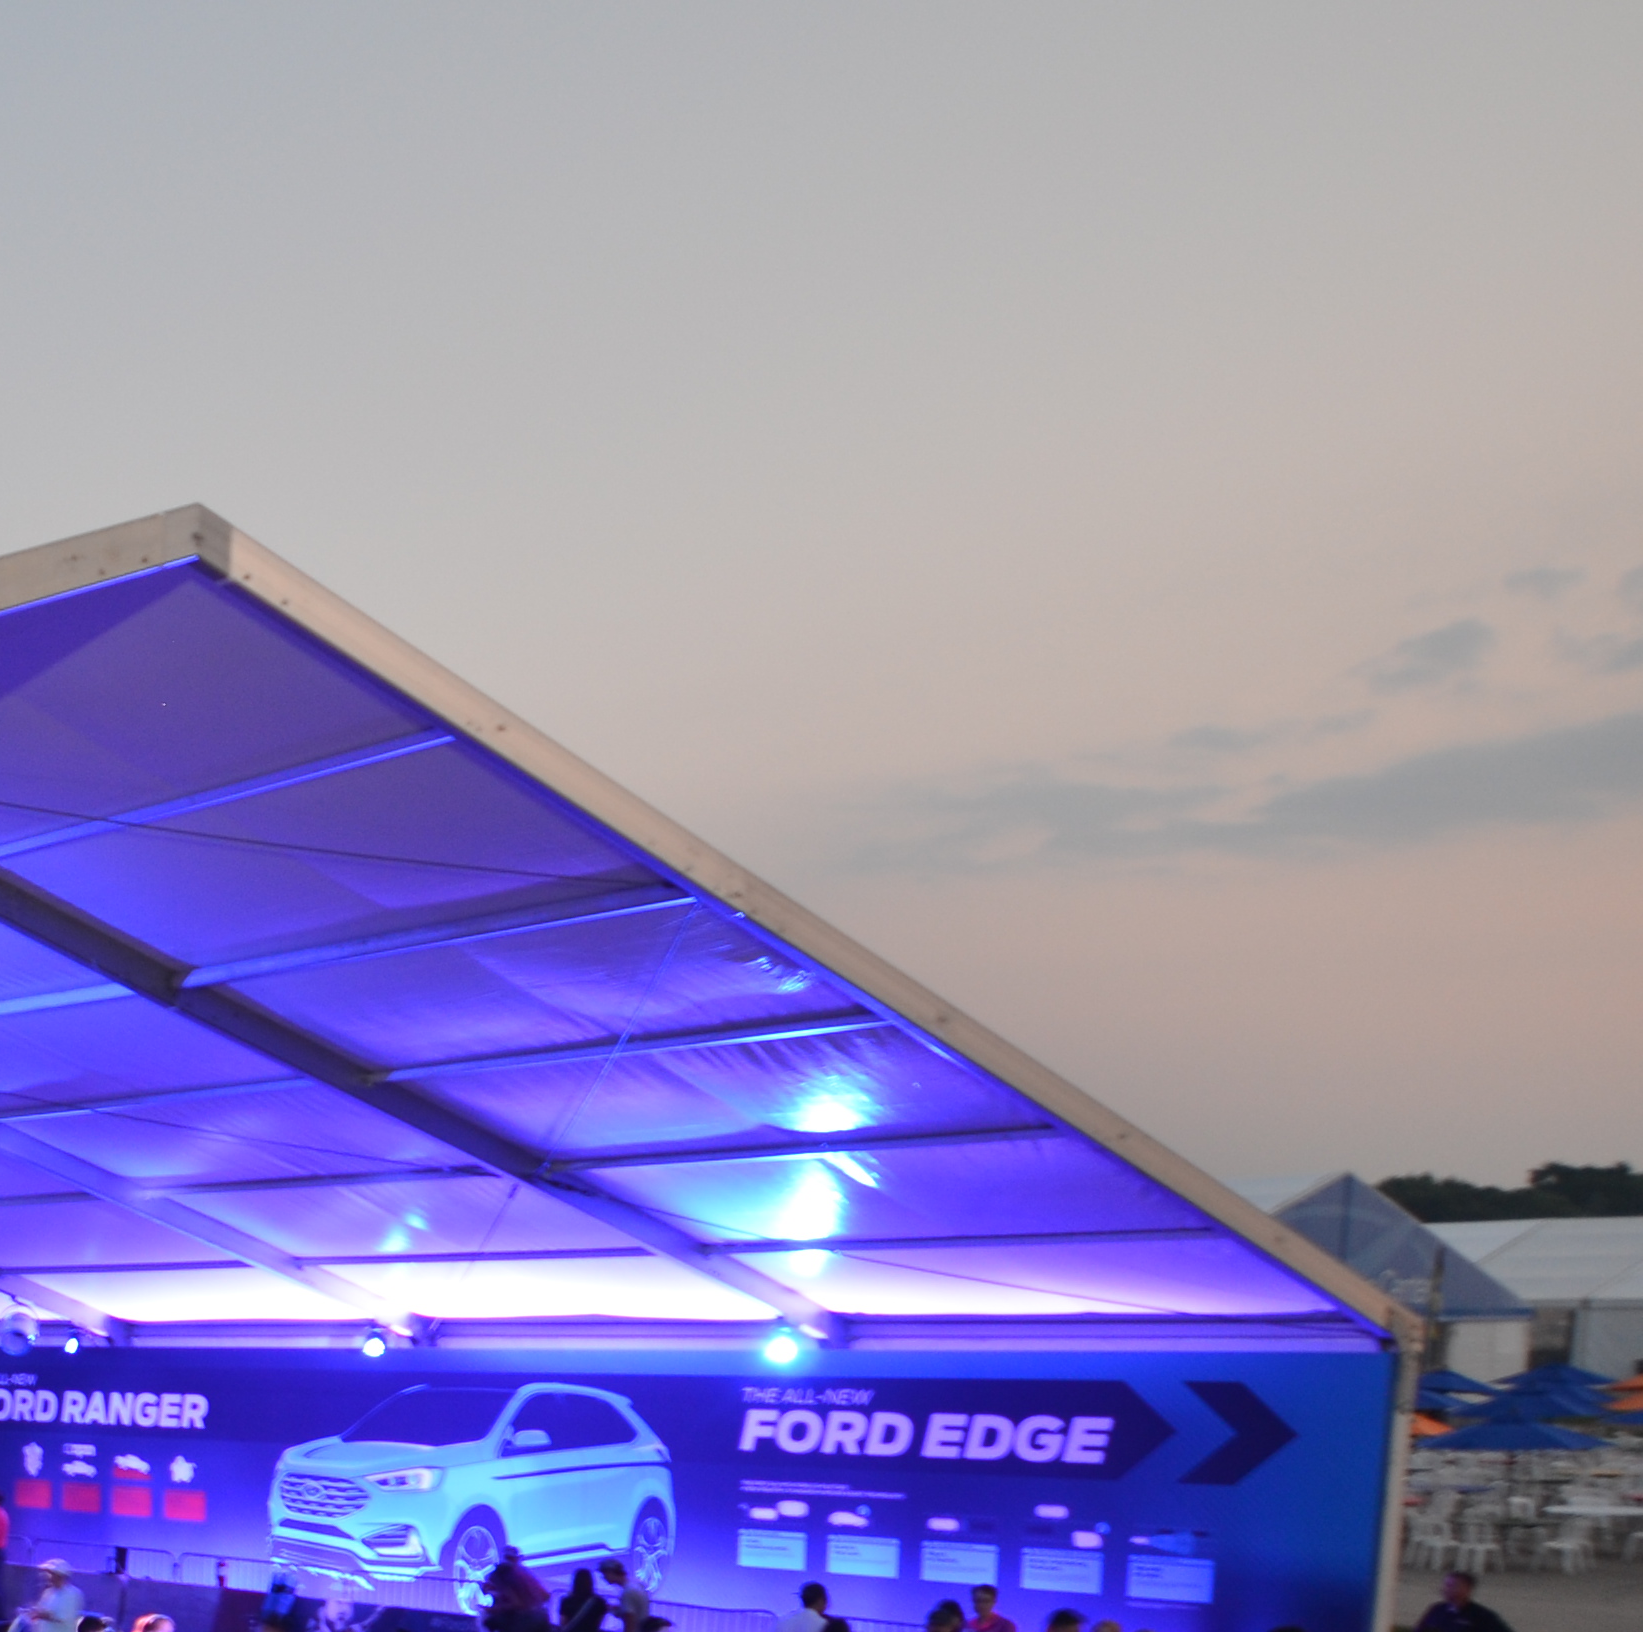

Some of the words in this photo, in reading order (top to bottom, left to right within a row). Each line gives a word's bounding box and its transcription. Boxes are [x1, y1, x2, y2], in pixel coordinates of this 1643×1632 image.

[60, 1390, 209, 1429] RANGER
[741, 1386, 781, 1404] THE
[781, 1387, 875, 1406] ALL-NEW
[738, 1408, 915, 1456] FORD
[919, 1412, 1114, 1464] EDGE
